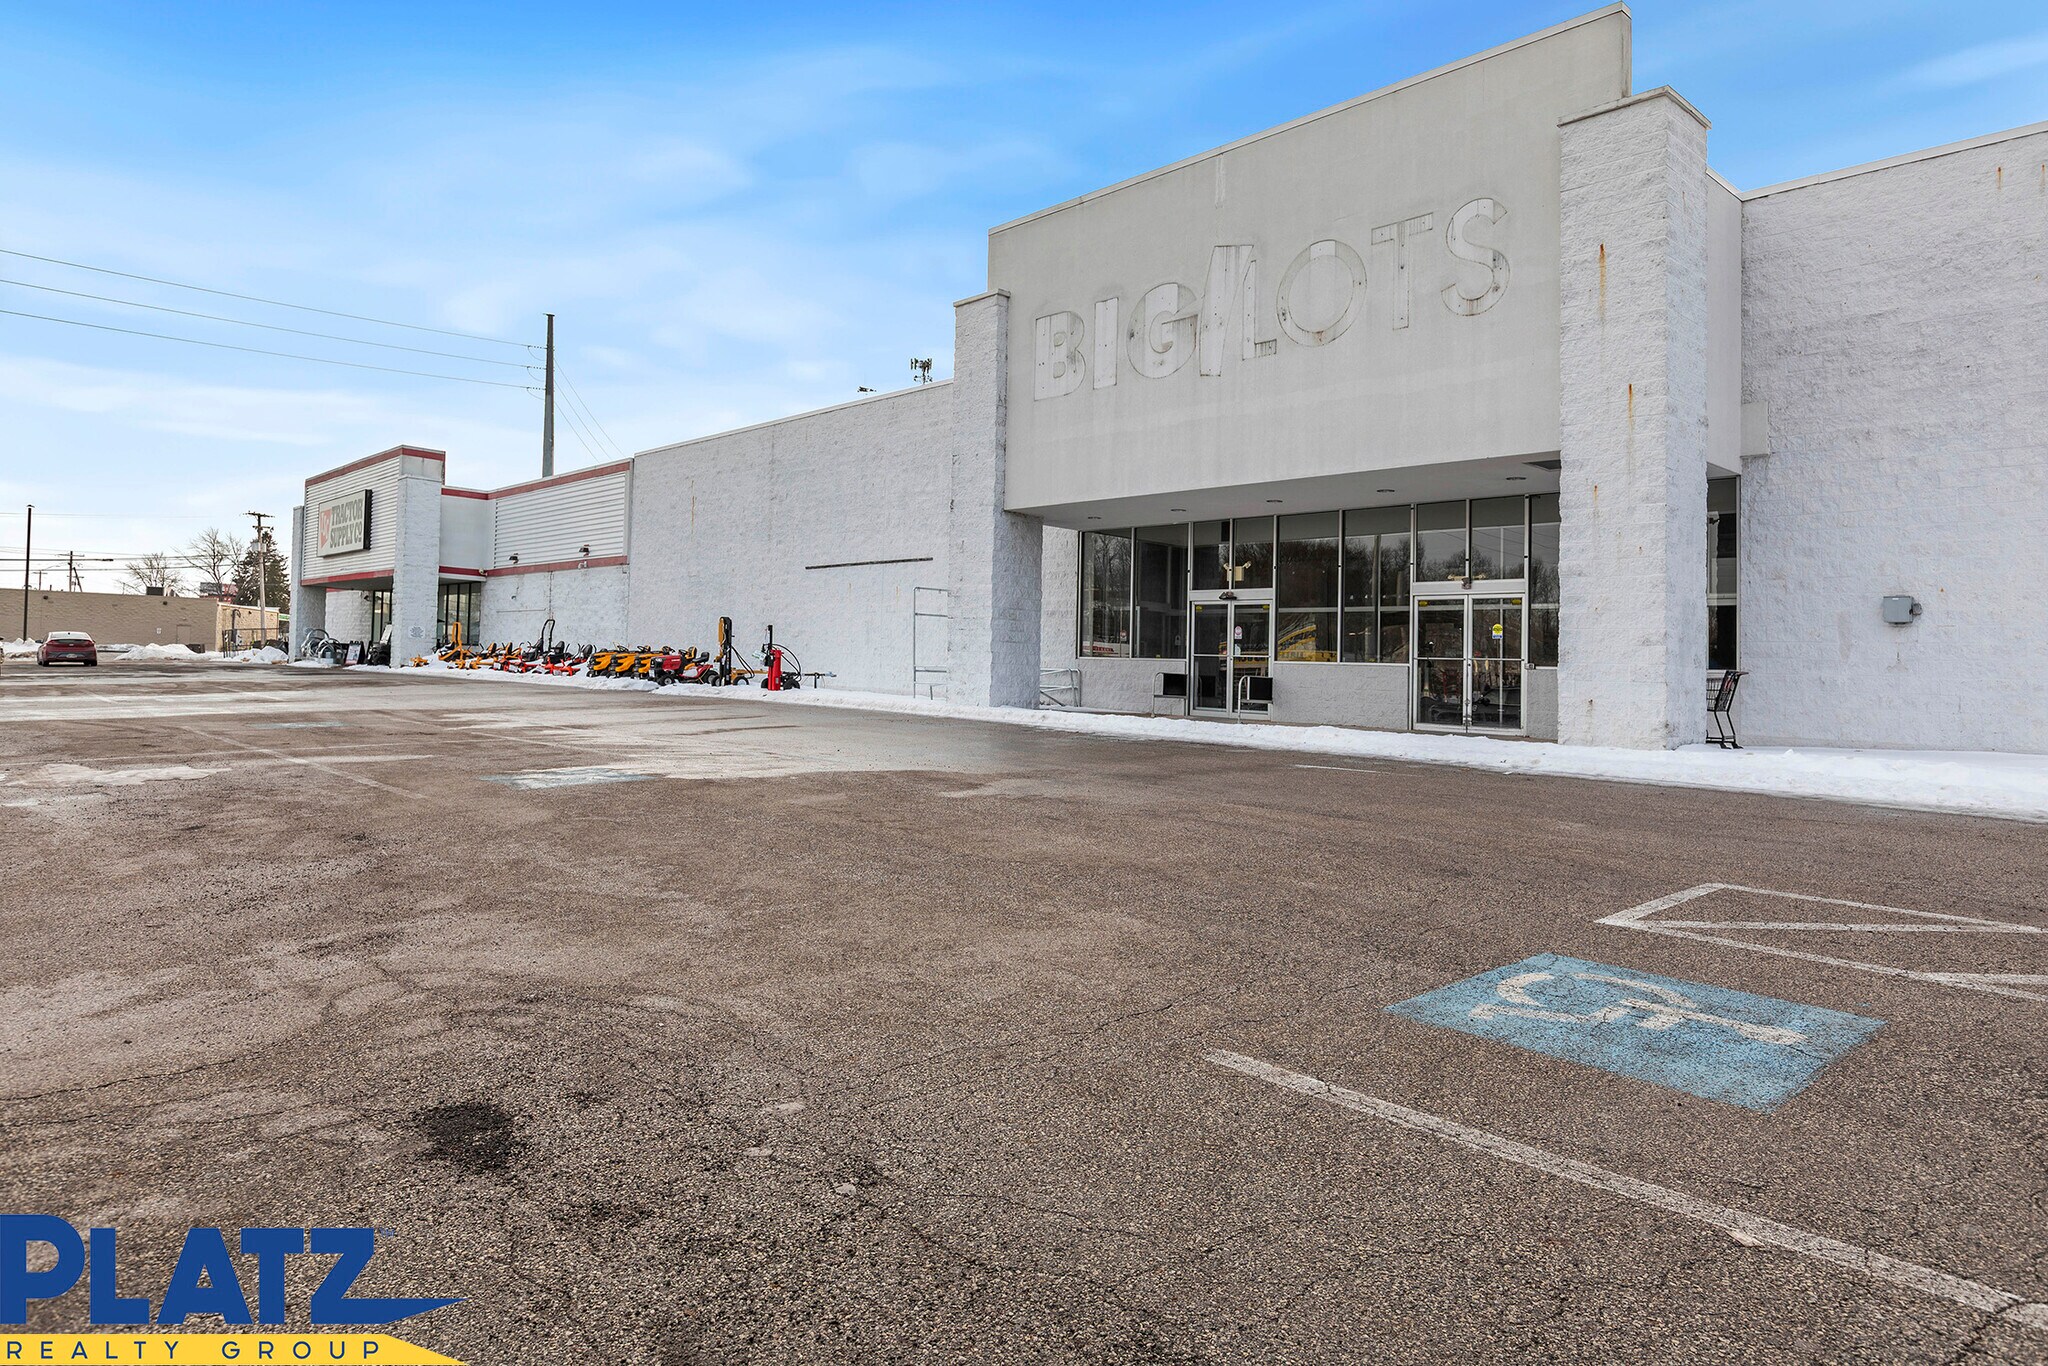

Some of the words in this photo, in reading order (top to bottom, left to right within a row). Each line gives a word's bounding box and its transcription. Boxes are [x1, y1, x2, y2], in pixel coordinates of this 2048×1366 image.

[1034, 282, 1199, 401] BIG
[1242, 197, 1511, 361] LOTS
[331, 499, 363, 526] TRACTOR
[330, 522, 354, 548] SUPPLY
